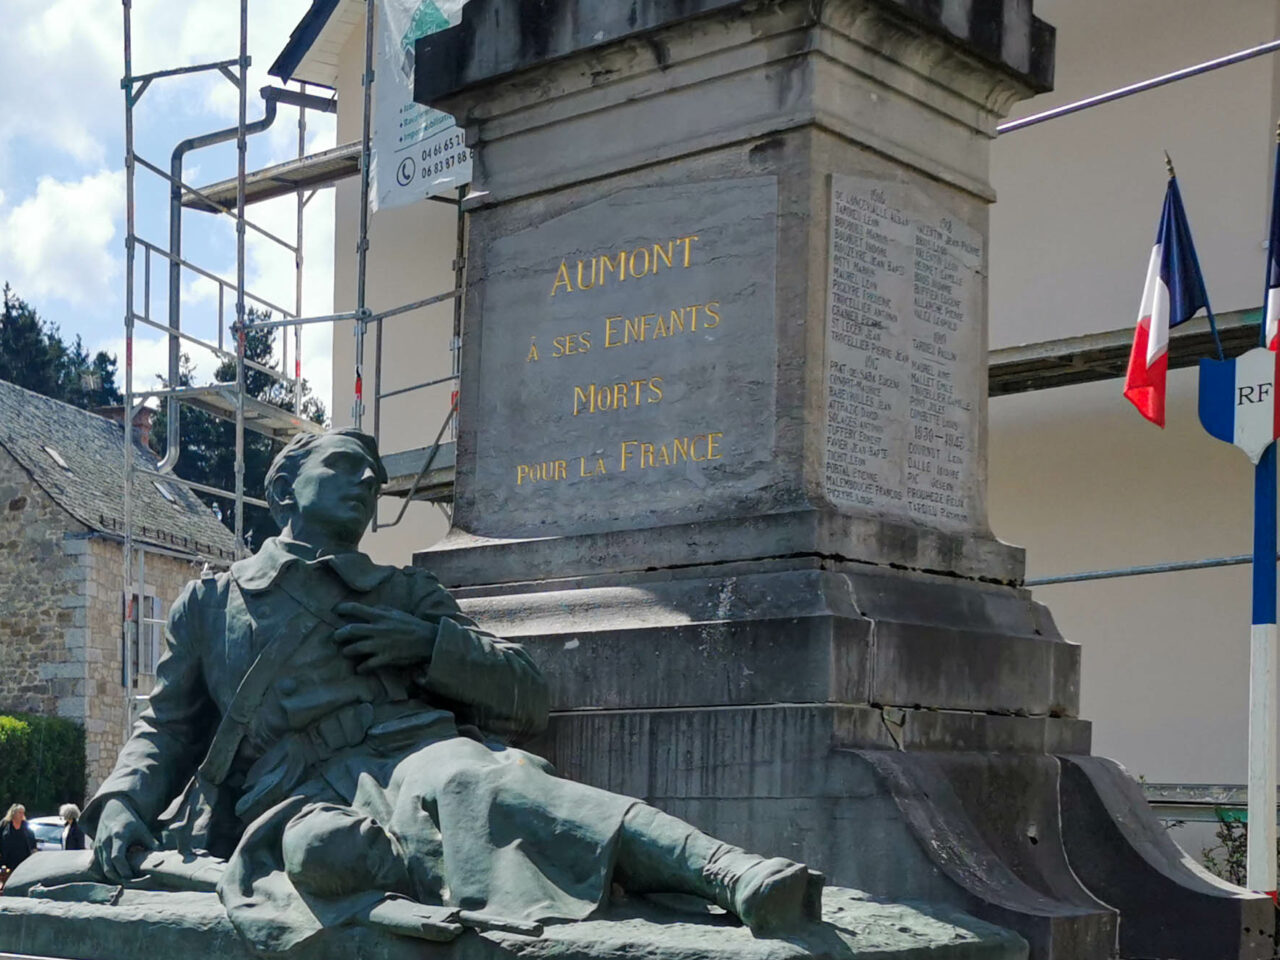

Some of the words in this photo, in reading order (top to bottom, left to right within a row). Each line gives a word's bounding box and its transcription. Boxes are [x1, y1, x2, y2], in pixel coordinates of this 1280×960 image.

[421, 165, 432, 178] 06
[434, 160, 443, 174] 83
[445, 155, 455, 169] 87
[457, 150, 467, 164] 88
[422, 148, 431, 161] 04
[444, 138, 454, 151] 65
[455, 132, 464, 146] 21
[551, 235, 699, 296] AUMONT
[552, 331, 591, 357] SES
[604, 301, 721, 348] ENFANTS
[573, 376, 664, 416] MORTS
[1237, 382, 1273, 406] RF
[517, 459, 568, 485] POUR
[580, 456, 607, 477] LA
[620, 432, 724, 472] FRANCE
